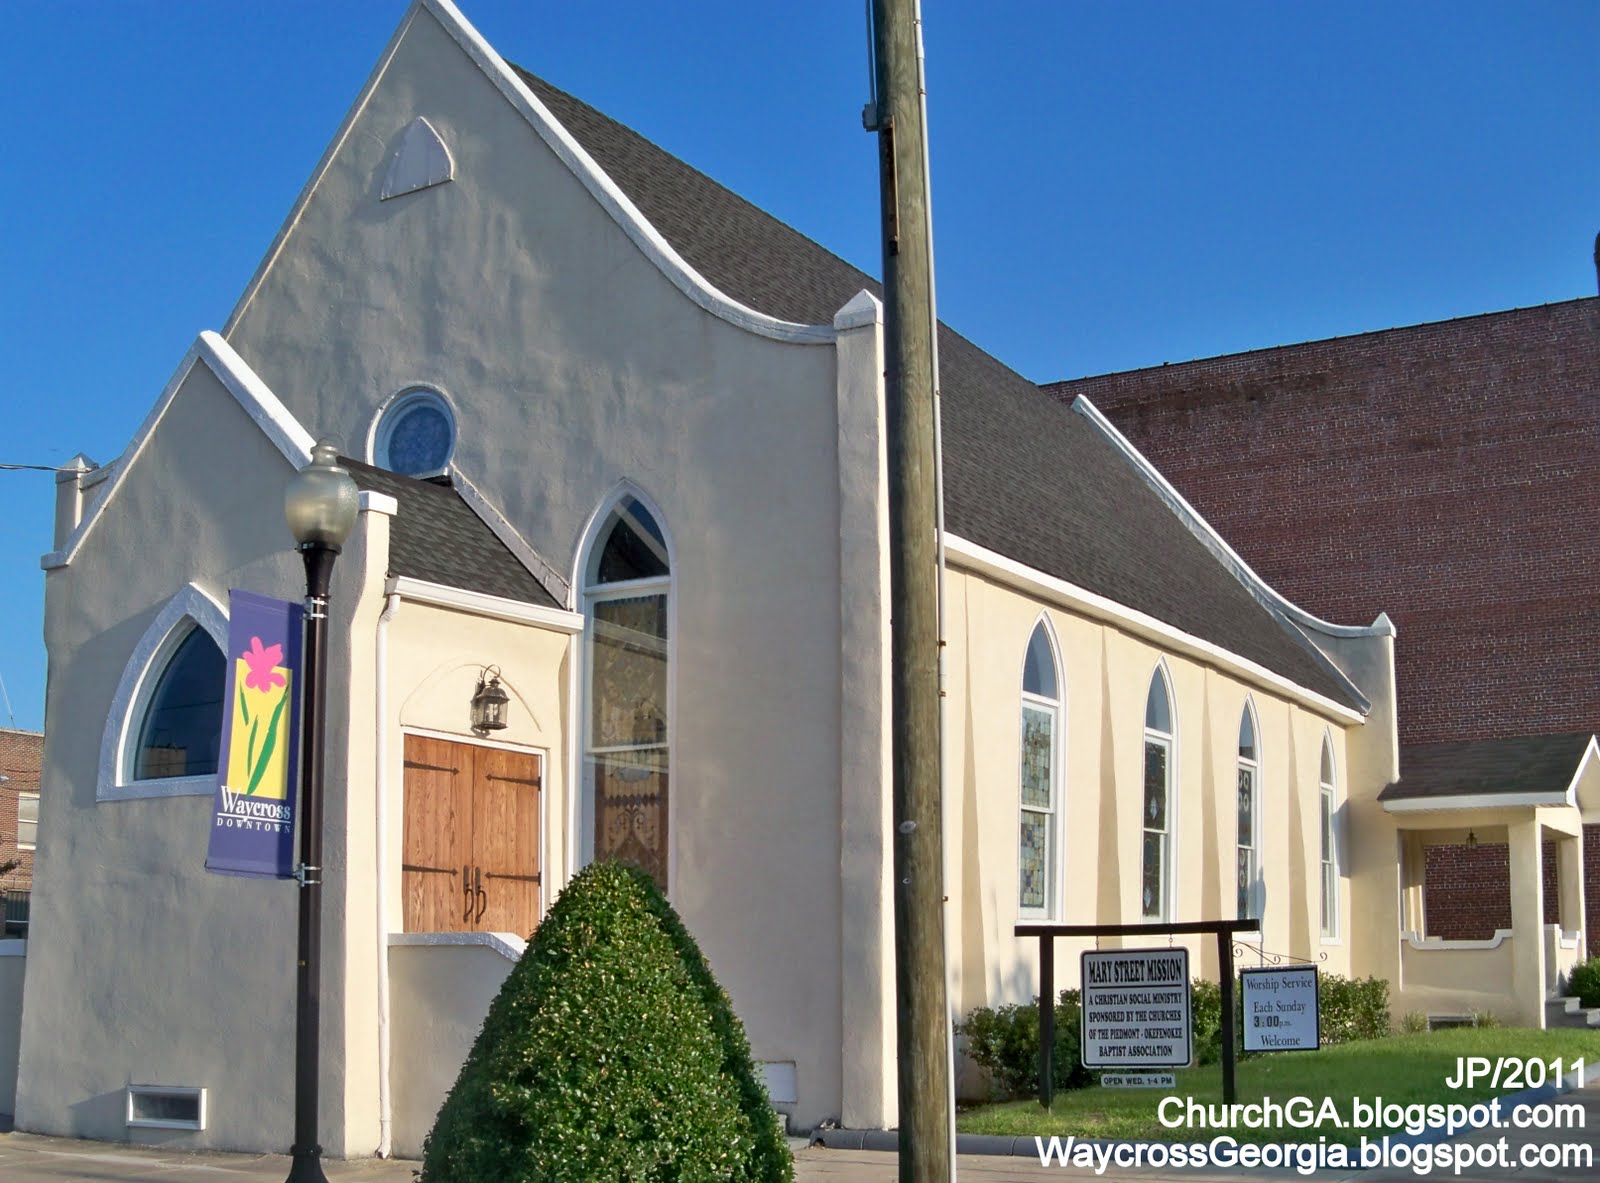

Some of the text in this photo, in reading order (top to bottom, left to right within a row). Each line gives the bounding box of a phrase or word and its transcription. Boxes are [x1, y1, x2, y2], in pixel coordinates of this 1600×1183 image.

[221, 785, 291, 822] Waycross
[217, 817, 291, 833] DOWNTOWN
[1089, 958, 1182, 983] MARY STREET MISSION
[1246, 976, 1313, 993] Worship Service
[1089, 992, 1182, 1005] A CHRISTIAN SOCIAL MINISTRY
[1254, 1000, 1305, 1015] Each Sunday
[1089, 1009, 1182, 1022] SPONSORED BY THE CHURCHES
[1089, 1029, 1097, 1040] OF
[1098, 1029, 1109, 1039] THE
[1110, 1028, 1140, 1039] PIEDMONT
[1144, 1027, 1182, 1039] OKEFENOKEE
[1261, 1034, 1301, 1047] Welcome
[1099, 1045, 1173, 1057] BAPTIST ASSOCIATION
[1147, 1077, 1158, 1085] 1-4
